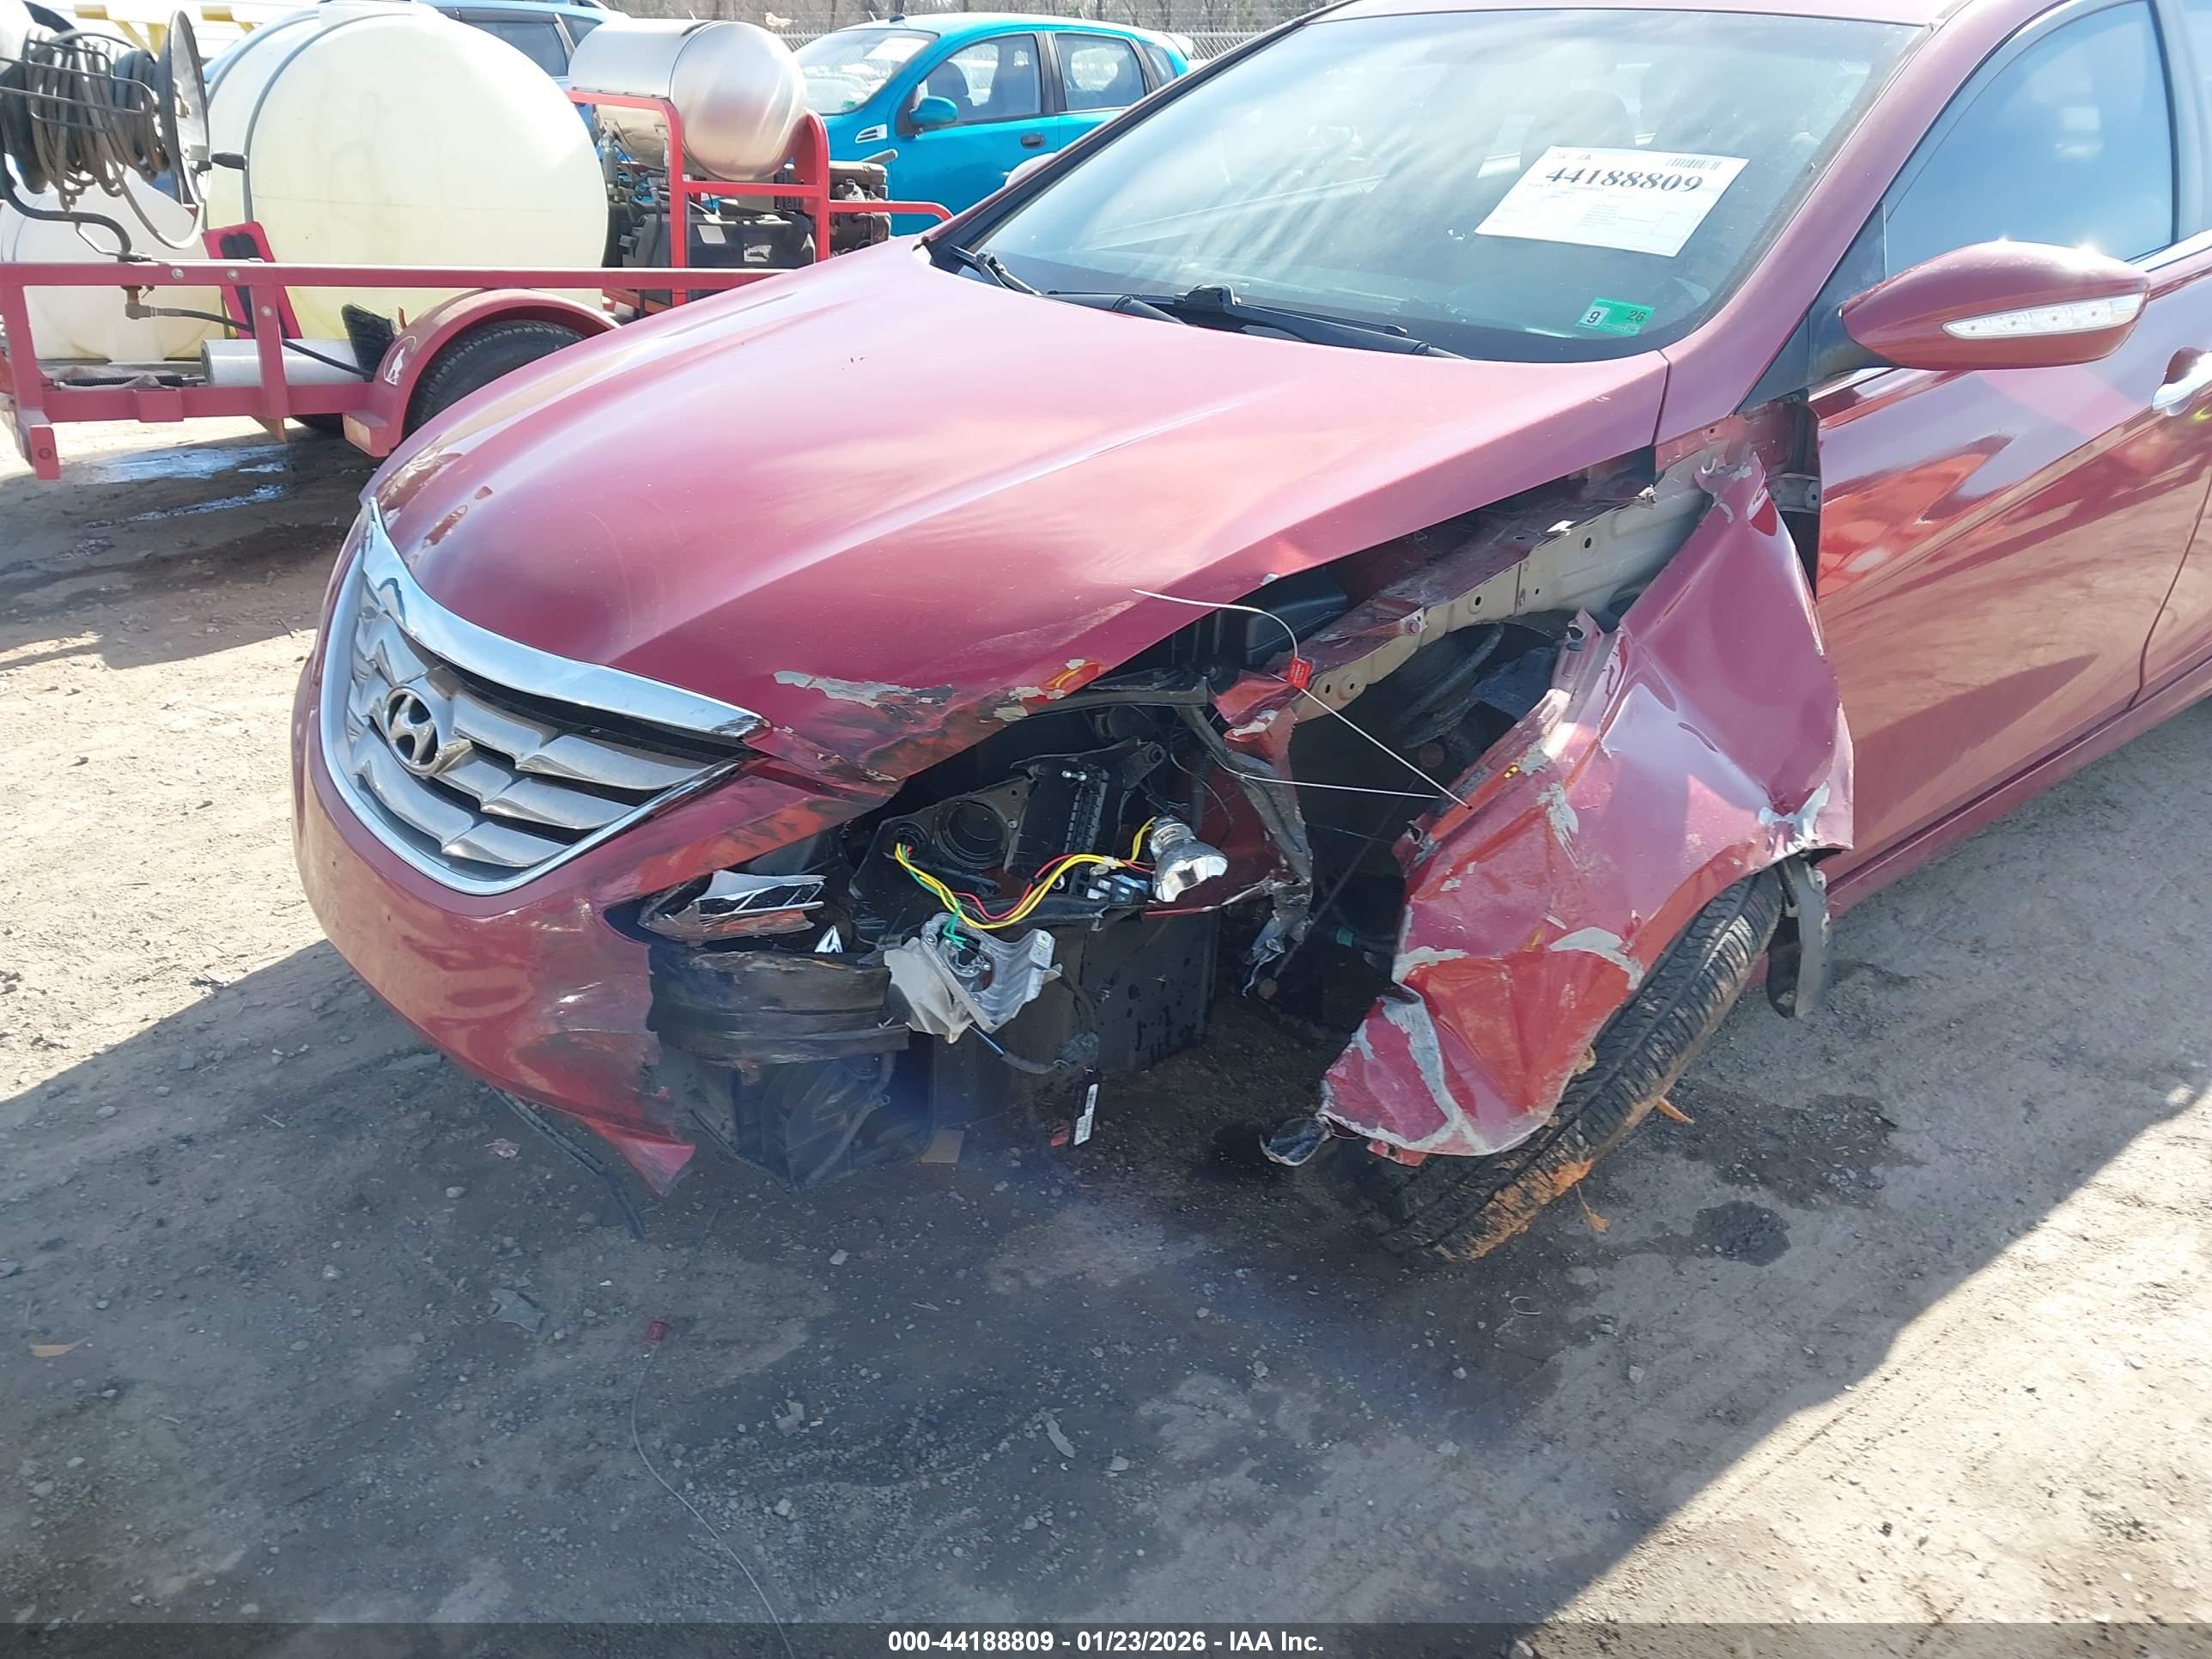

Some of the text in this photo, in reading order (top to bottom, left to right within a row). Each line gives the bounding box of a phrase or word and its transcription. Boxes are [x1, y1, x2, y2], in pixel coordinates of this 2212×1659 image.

[1545, 167, 1704, 192] 44188809
[1586, 309, 1647, 324] 9 26
